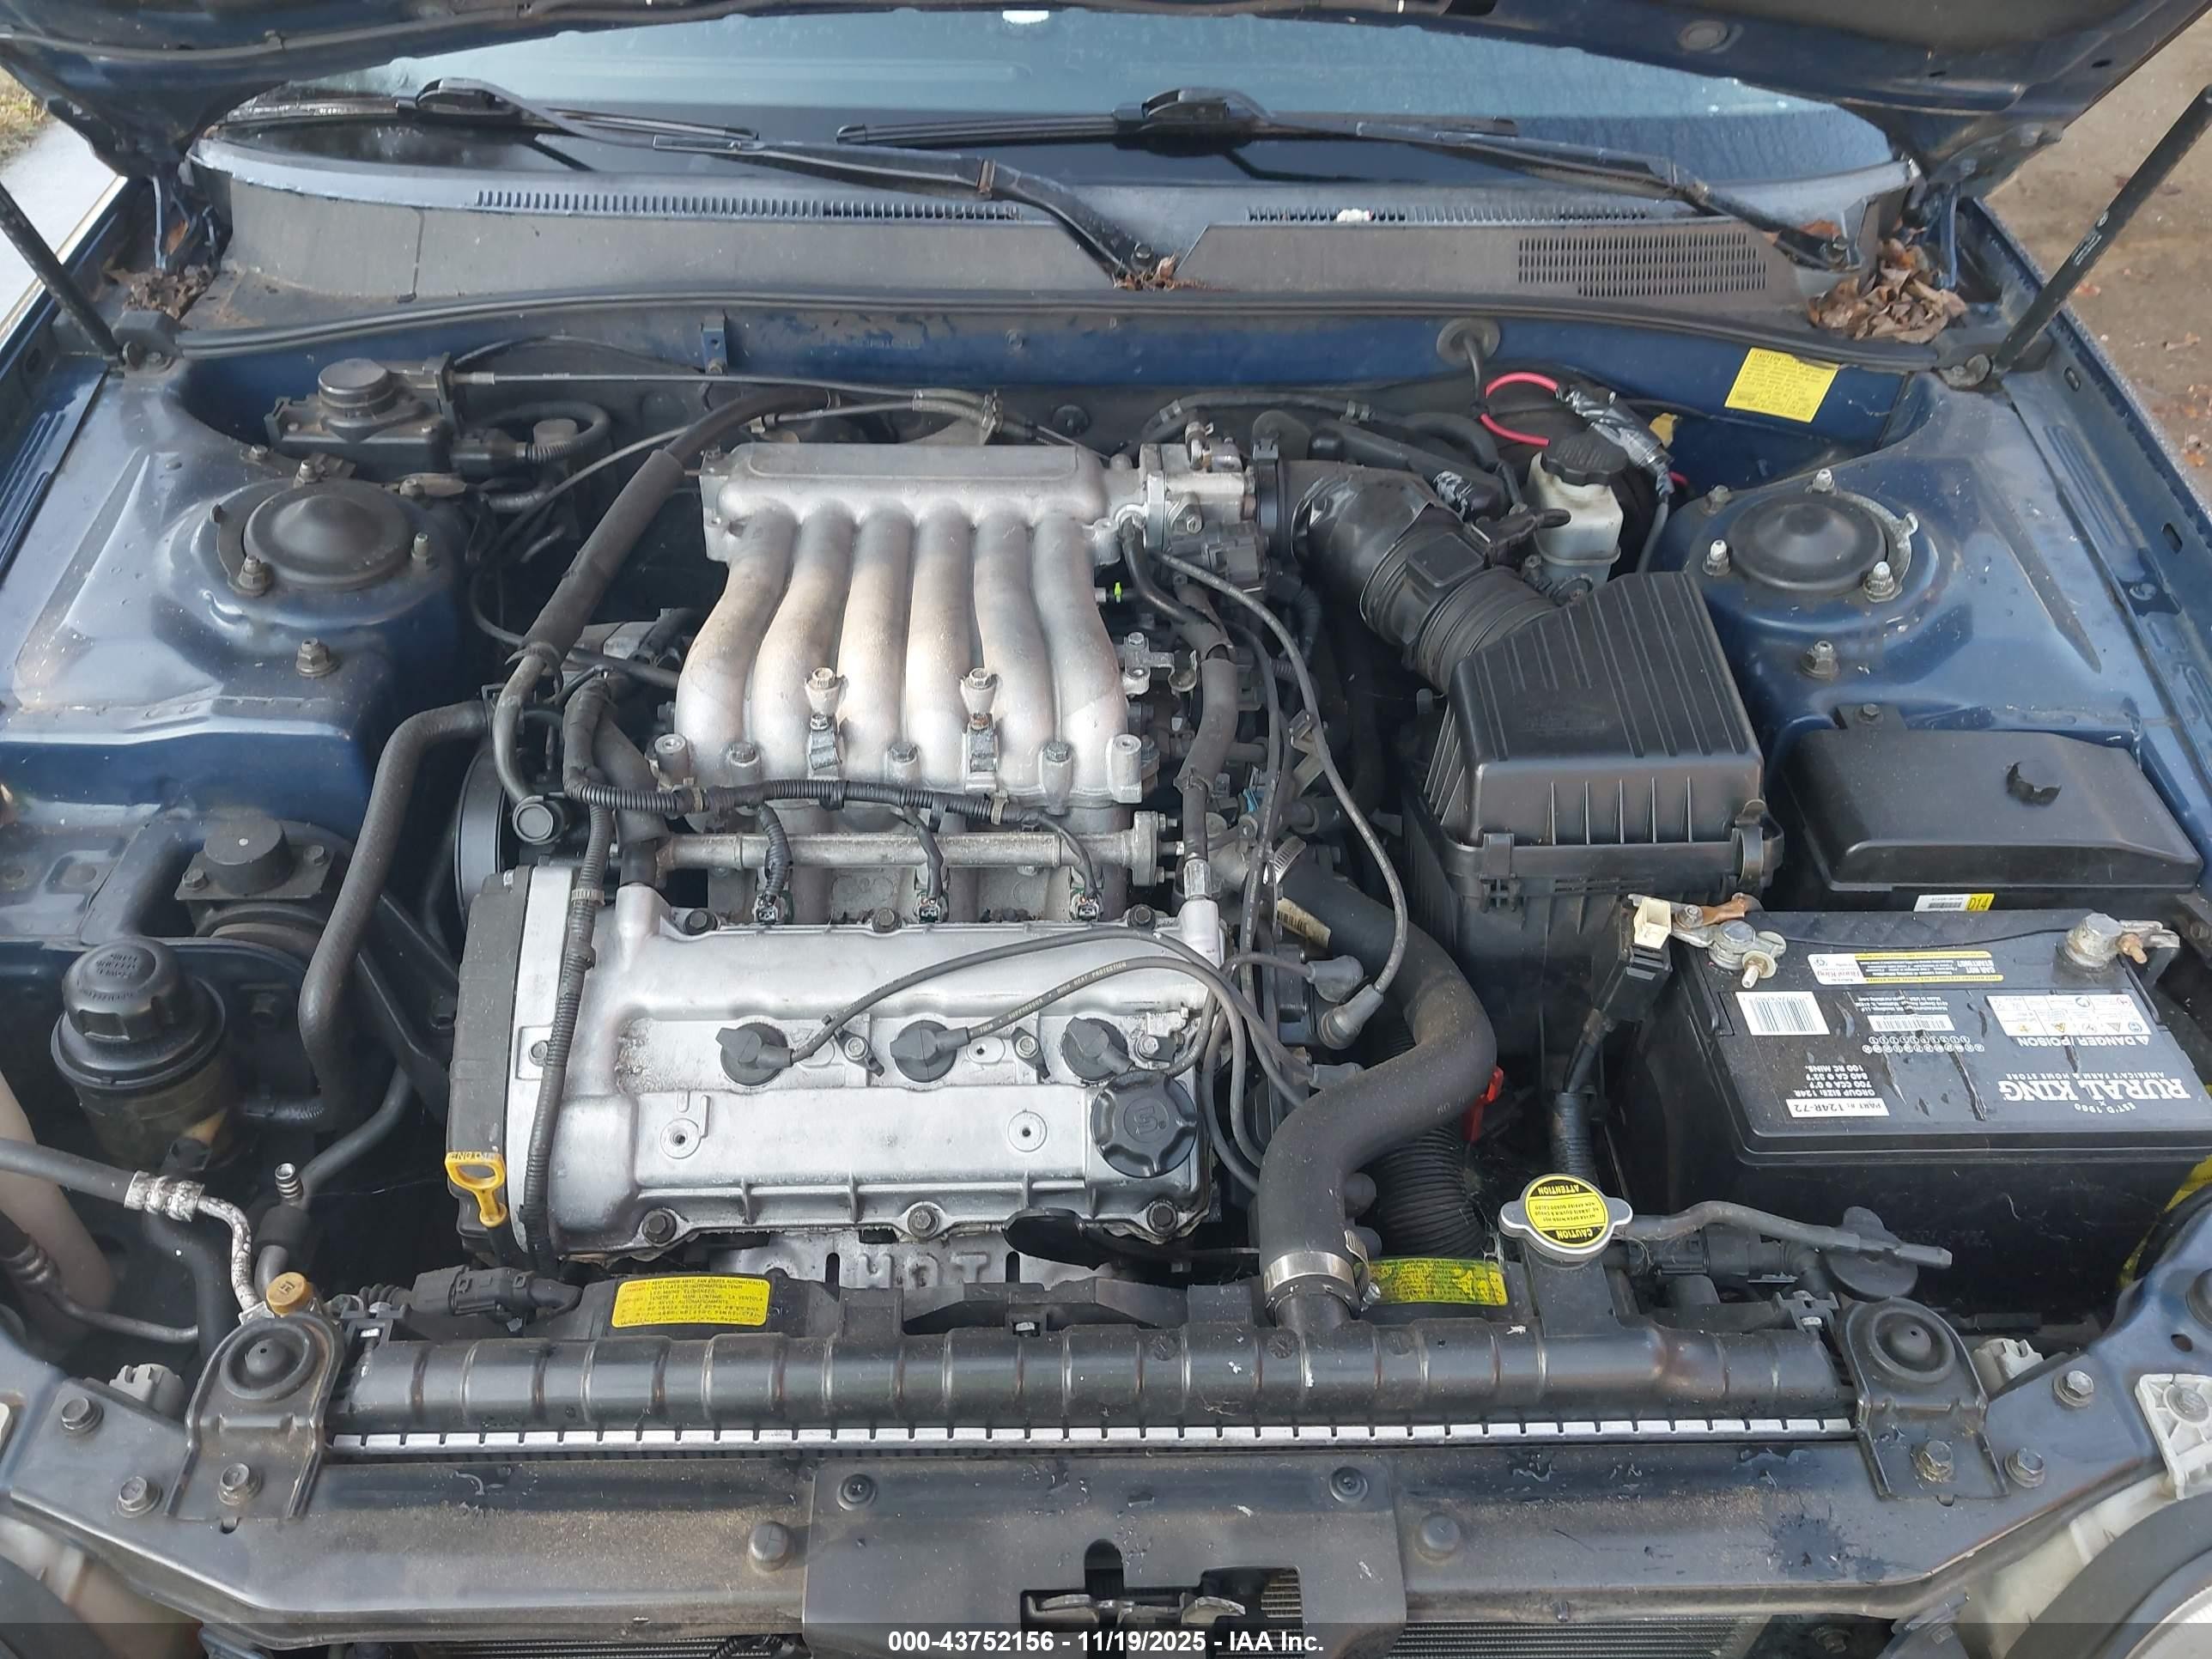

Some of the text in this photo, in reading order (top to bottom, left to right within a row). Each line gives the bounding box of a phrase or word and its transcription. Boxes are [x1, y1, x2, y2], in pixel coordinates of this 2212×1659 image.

[1968, 896, 1989, 910] D14
[1091, 961, 1127, 978] PROTECTION
[2075, 1036, 2137, 1046] DANGER
[1846, 1064, 1864, 1073] 100
[1833, 1080, 1852, 1089] CCA
[1998, 1078, 2191, 1101] RURAL KING
[1793, 1089, 1818, 1097] 124R
[1794, 1103, 1844, 1113] 124R-72
[2106, 1101, 2136, 1114] EST'D
[1537, 1185, 1579, 1195] ATTENTION
[1555, 1228, 1593, 1239] CAUTION
